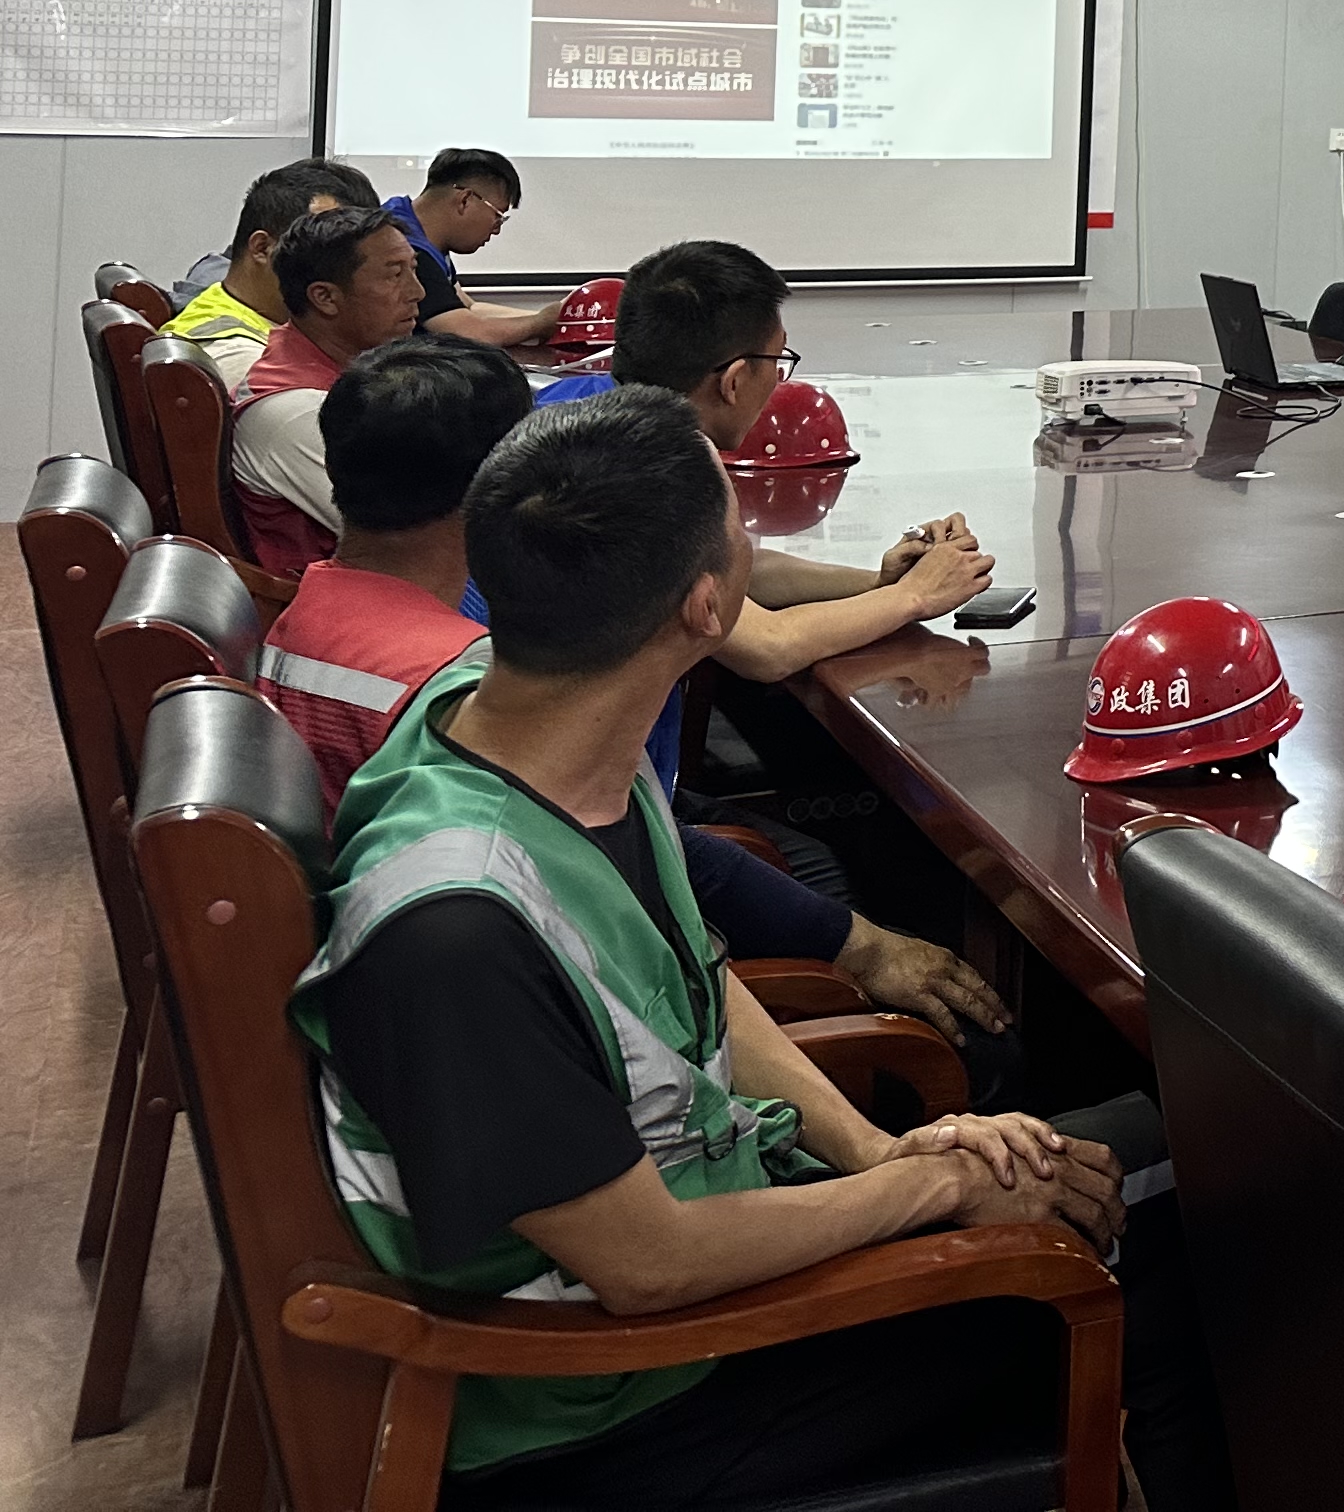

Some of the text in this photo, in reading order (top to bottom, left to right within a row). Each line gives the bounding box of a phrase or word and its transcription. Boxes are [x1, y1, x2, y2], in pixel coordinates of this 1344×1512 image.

[560, 44, 743, 68] 争创全国市域社会
[547, 67, 753, 92] 治理现代化试点城市
[1109, 678, 1191, 716] 政集团
